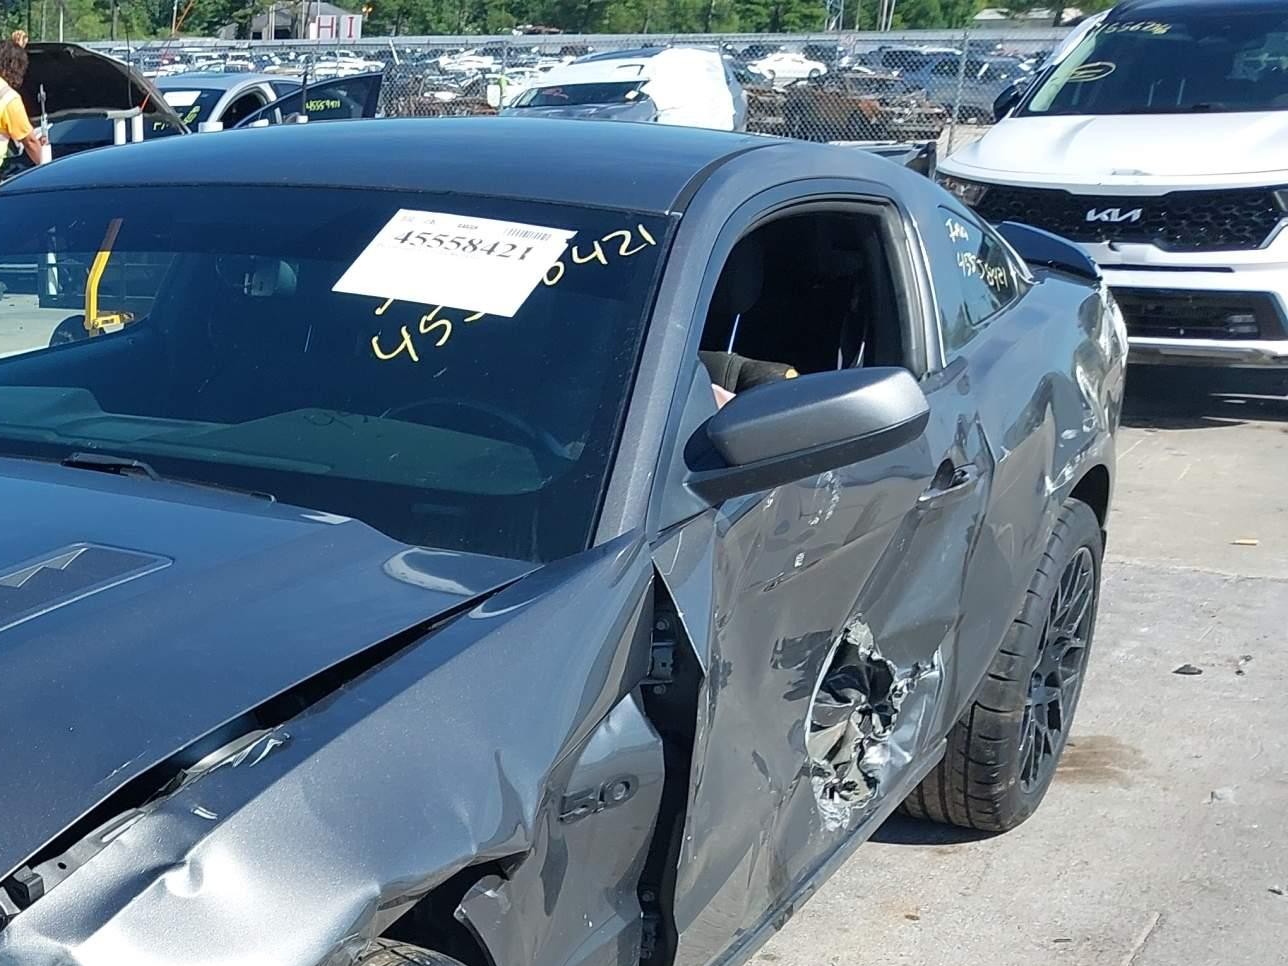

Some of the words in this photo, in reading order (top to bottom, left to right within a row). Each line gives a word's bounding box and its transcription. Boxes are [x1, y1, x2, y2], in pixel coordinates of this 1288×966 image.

[1086, 208, 1143, 222] KIA
[394, 230, 534, 261] 45558421
[558, 774, 640, 825] 5.0
